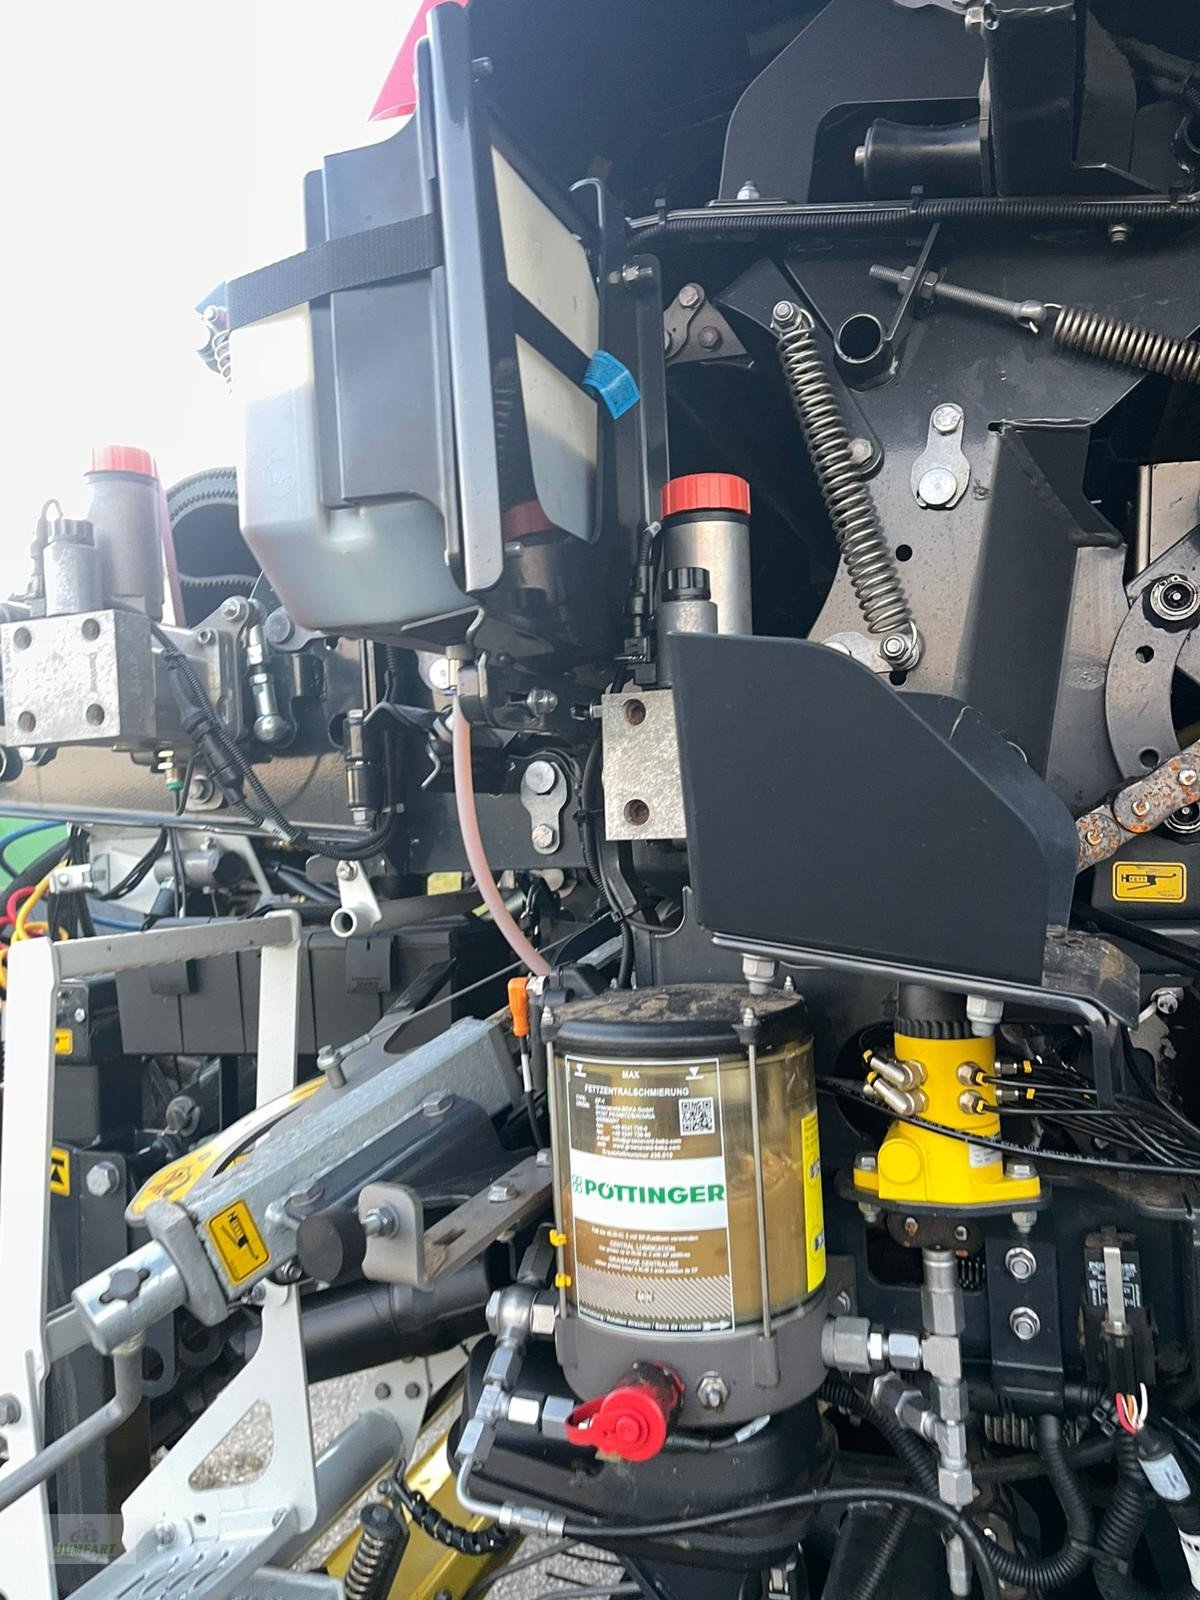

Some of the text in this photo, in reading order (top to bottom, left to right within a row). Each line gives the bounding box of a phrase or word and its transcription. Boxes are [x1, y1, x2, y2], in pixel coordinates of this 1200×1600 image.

[621, 1070, 640, 1079] MAX
[585, 1084, 689, 1096] FETTZENTRALSCHMIERUNG
[585, 1179, 725, 1204] PÖTTINGER
